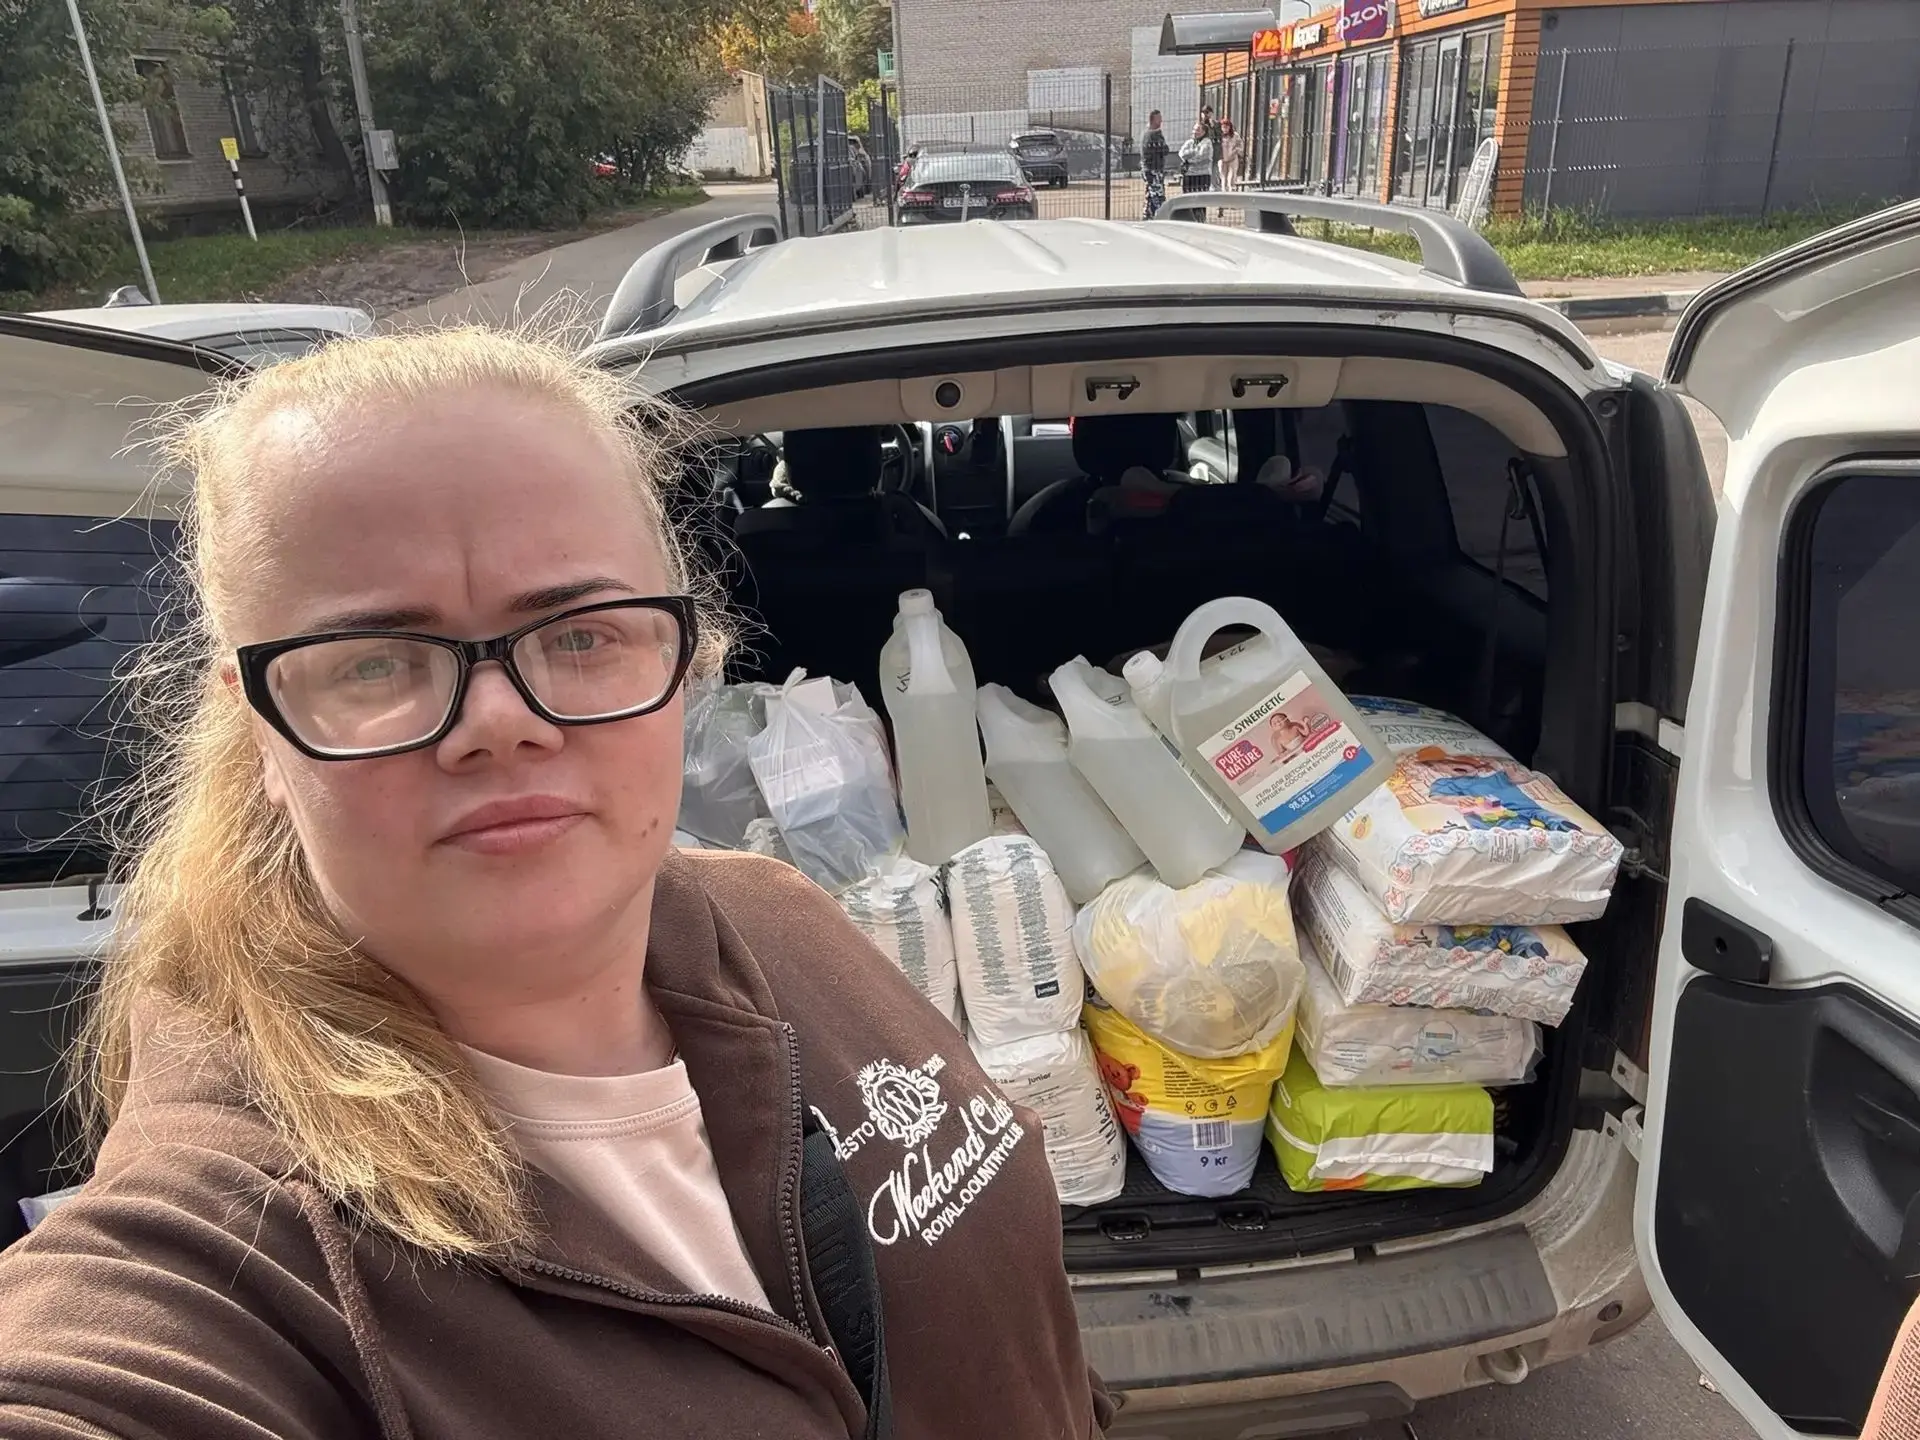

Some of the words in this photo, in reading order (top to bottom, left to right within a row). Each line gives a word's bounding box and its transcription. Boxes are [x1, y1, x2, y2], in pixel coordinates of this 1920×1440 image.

[1335, 0, 1389, 32] OZON
[1234, 692, 1285, 734] SYNERGETIC
[1219, 746, 1245, 769] PURE
[1226, 747, 1261, 778] NATURE
[868, 1106, 986, 1246] Weekend
[970, 1085, 1014, 1136] Club
[1200, 1156, 1209, 1168] 9
[1214, 1156, 1229, 1167] кг
